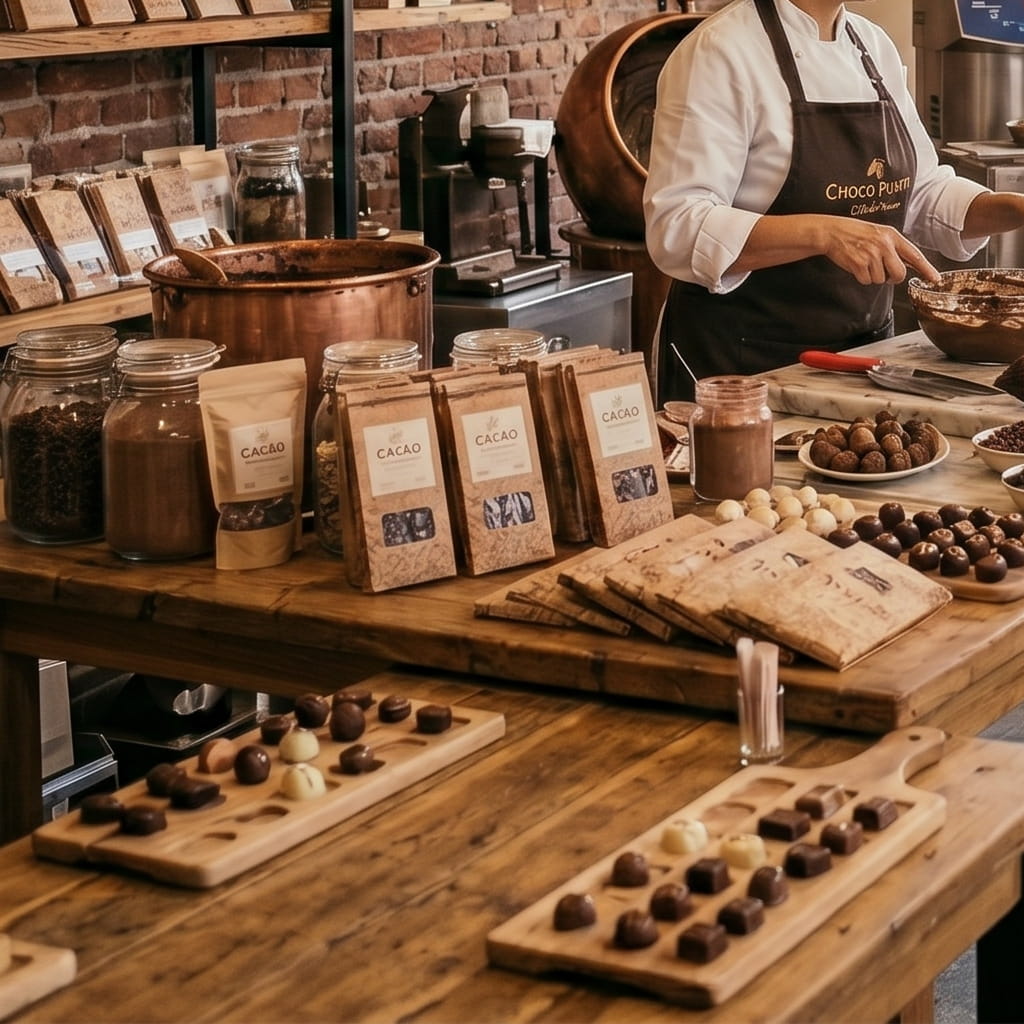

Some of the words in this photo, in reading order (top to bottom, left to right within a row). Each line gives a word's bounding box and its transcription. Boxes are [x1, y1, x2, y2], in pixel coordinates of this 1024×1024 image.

[825, 183, 875, 200] CHOCO
[601, 406, 639, 423] CACAO
[475, 429, 518, 446] CACAO
[240, 441, 285, 459] CACAO
[376, 442, 421, 459] CACAO
